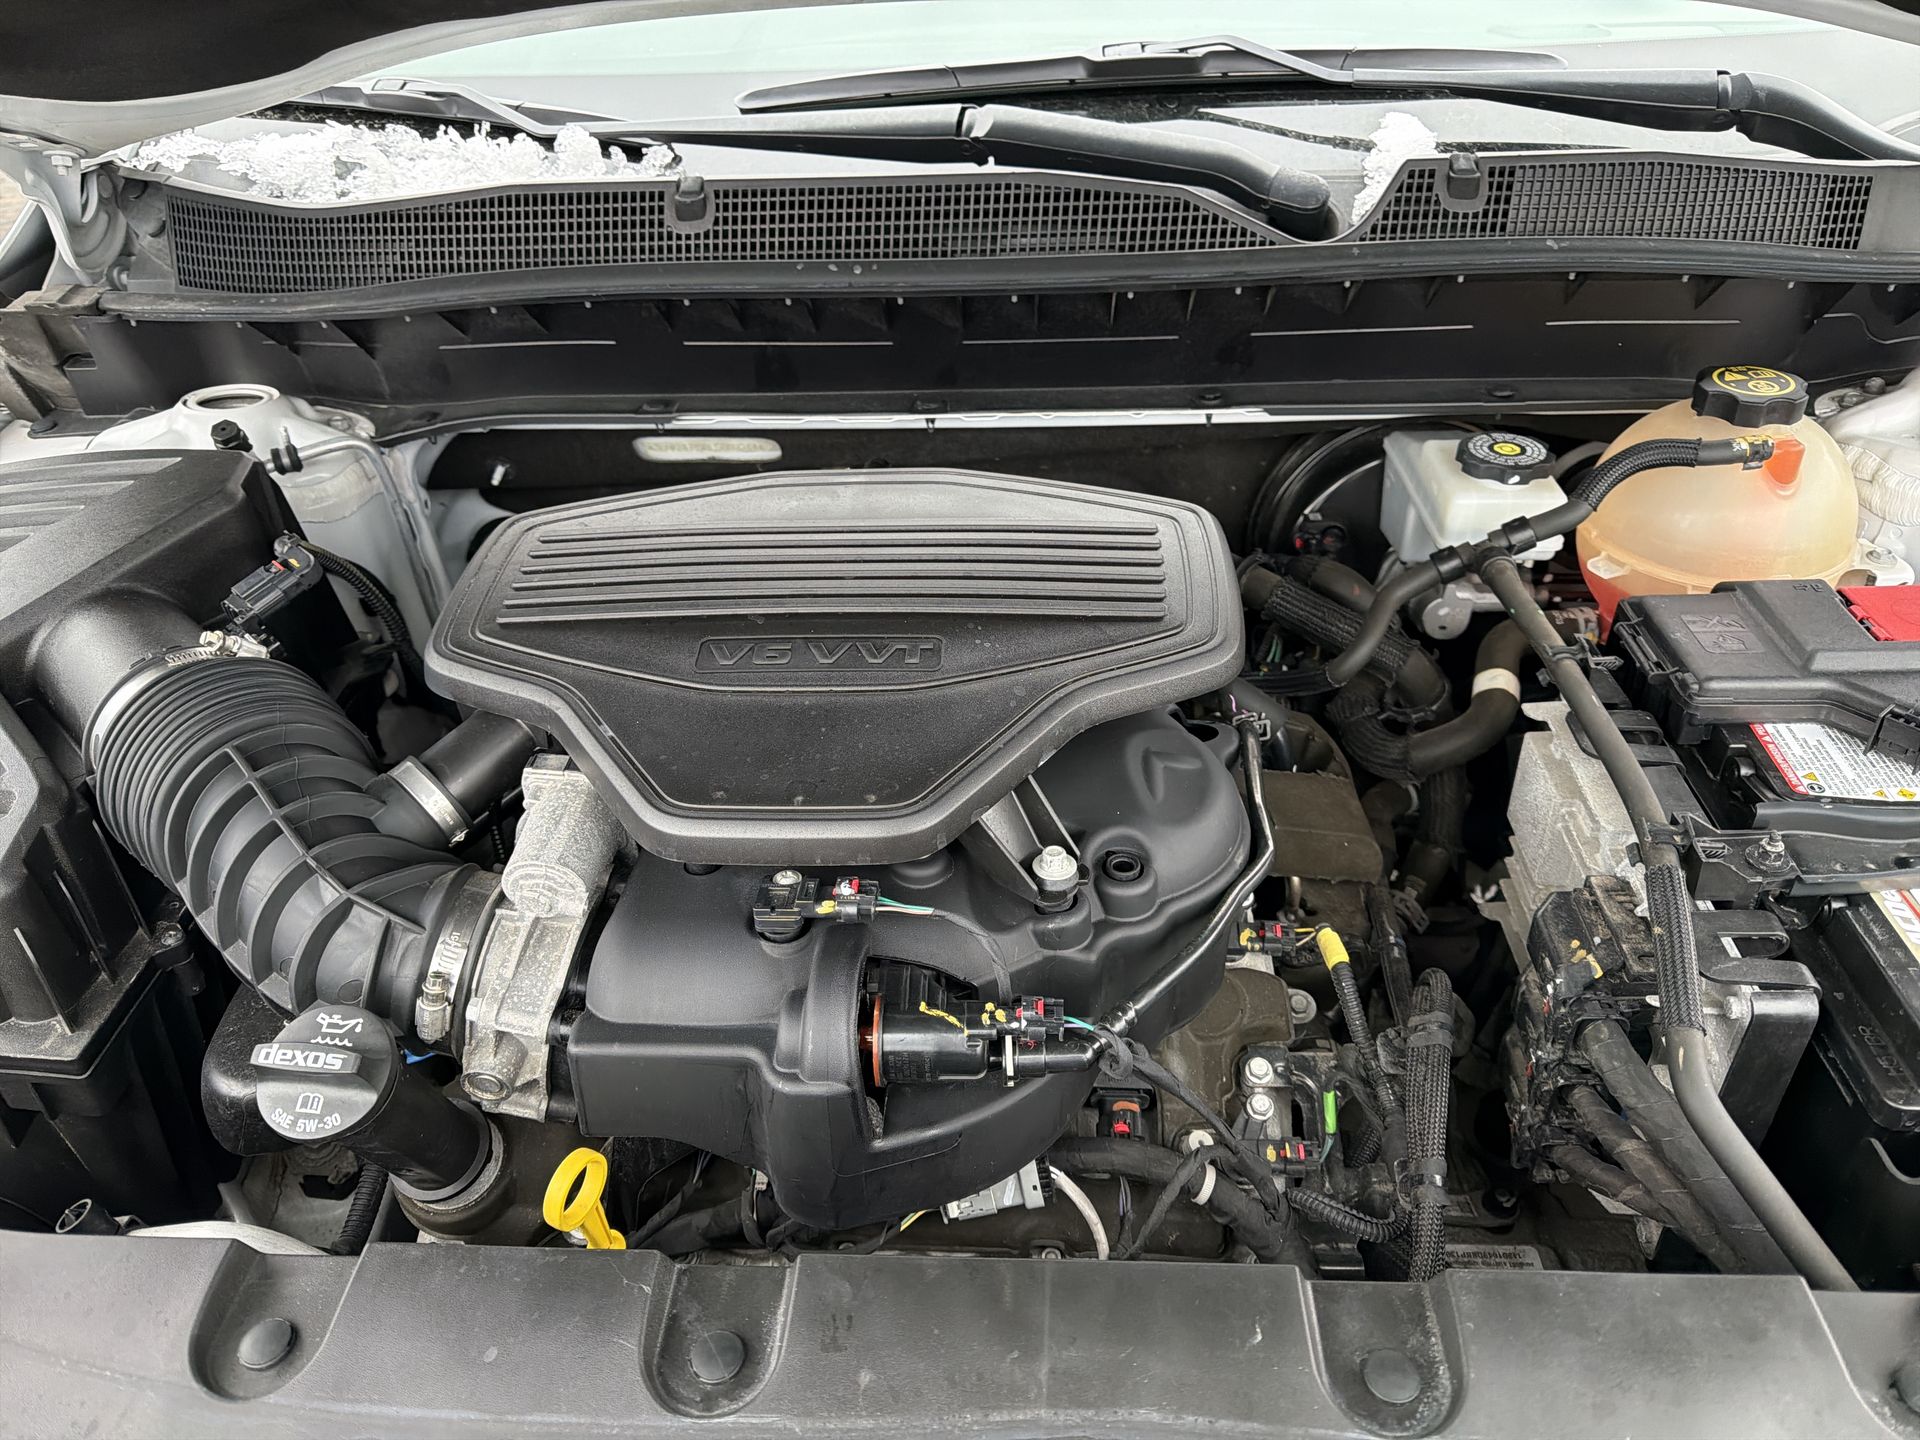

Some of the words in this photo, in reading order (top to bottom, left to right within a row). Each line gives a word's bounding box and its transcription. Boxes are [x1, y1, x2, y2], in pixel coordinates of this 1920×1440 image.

[709, 642, 793, 665] V6
[807, 642, 934, 664] VVT
[257, 1043, 347, 1070] dexos
[271, 1108, 295, 1129] SAE
[295, 1112, 342, 1133] 5W-30
